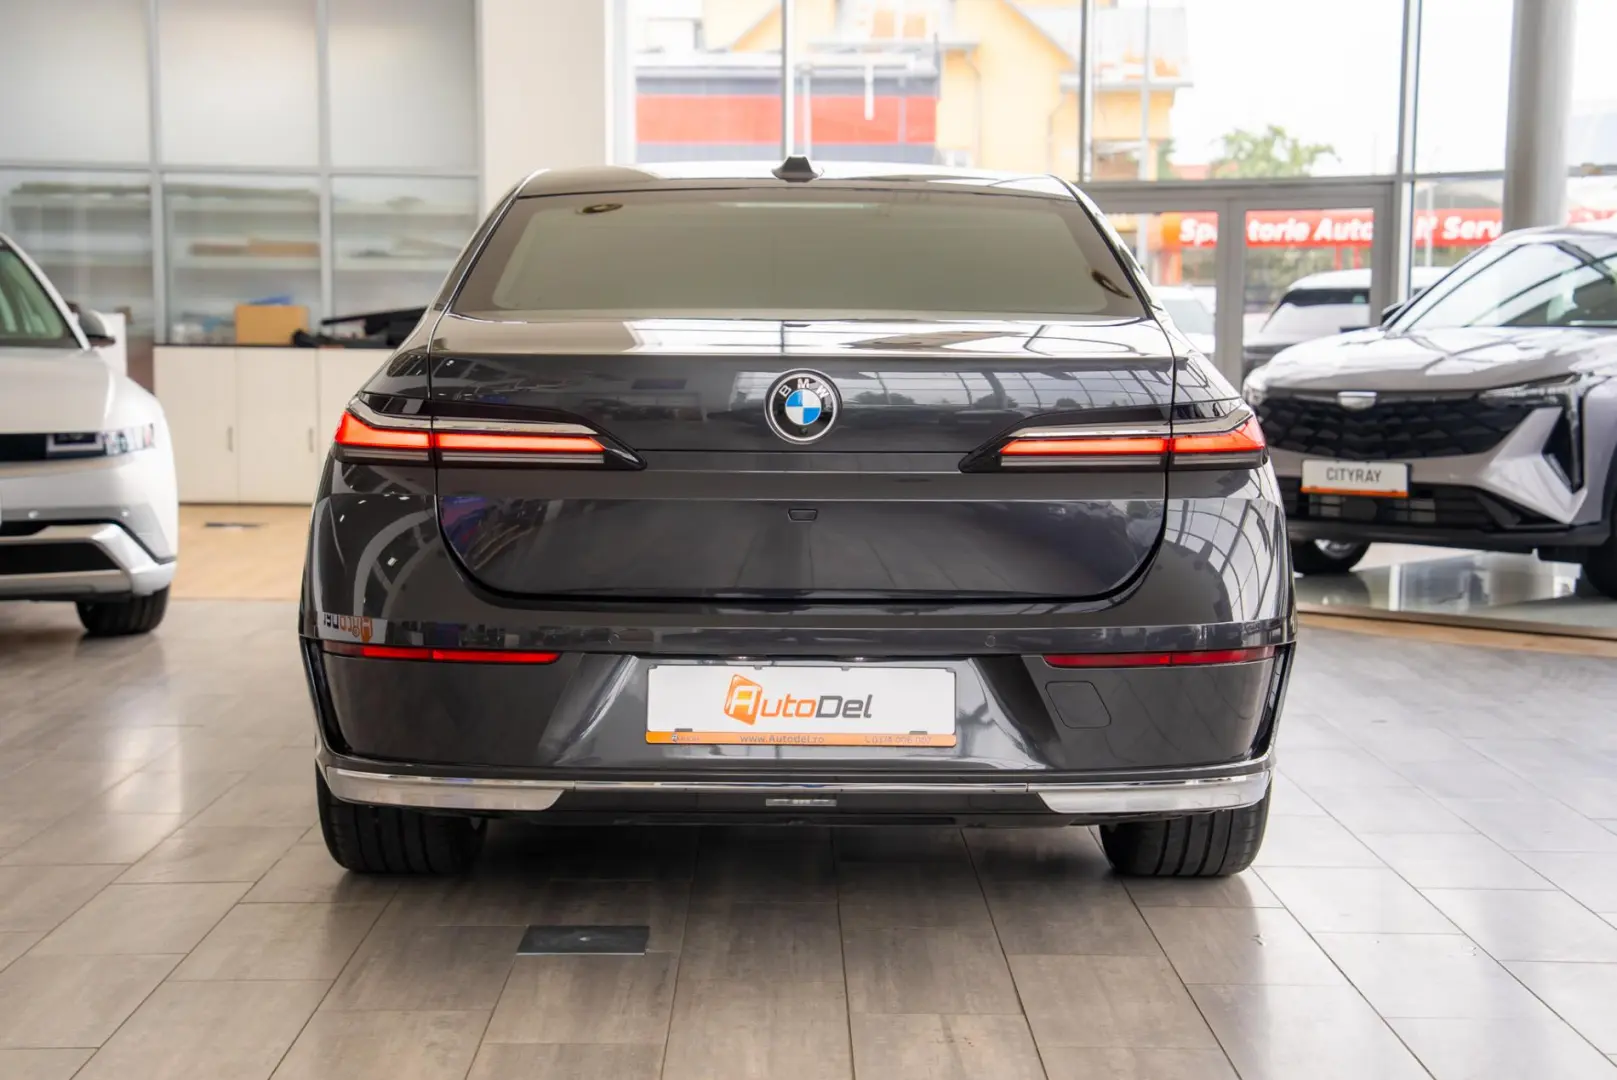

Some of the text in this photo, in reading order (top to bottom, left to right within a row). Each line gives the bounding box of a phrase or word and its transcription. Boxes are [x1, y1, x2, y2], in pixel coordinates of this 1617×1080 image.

[1443, 216, 1502, 240] Serv
[779, 378, 830, 398] BMW
[1326, 467, 1382, 483] CITYRAY
[725, 679, 873, 722] AutoDel
[739, 734, 825, 744] www.Autodel.ro
